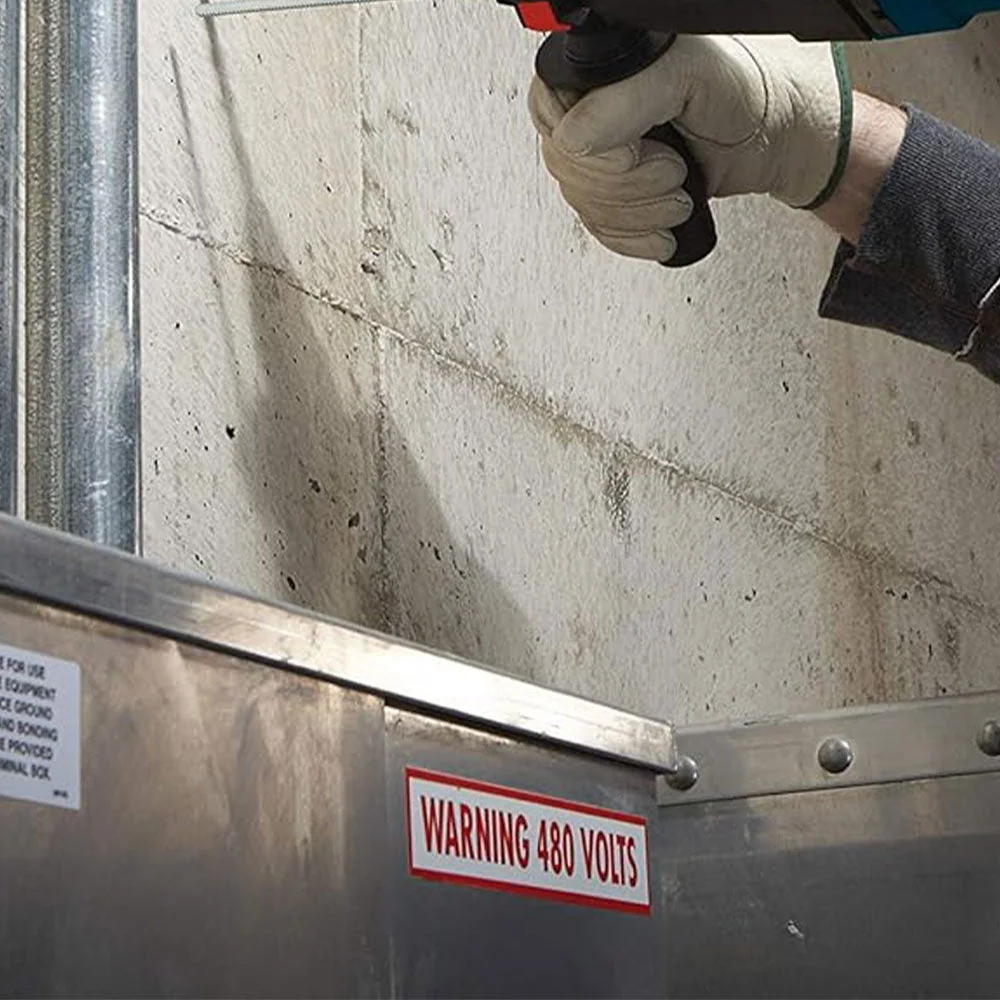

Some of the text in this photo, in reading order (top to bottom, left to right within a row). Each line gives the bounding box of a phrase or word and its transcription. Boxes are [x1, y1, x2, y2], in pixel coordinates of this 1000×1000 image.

[7, 657, 25, 674] FOR
[28, 662, 45, 680] USE
[5, 677, 56, 699] EQUIPMENT
[14, 699, 53, 721] GROUND
[17, 720, 58, 741] BONDING
[8, 739, 53, 760] PROVIDED
[420, 795, 638, 888] WARNING 480 VOLTS
